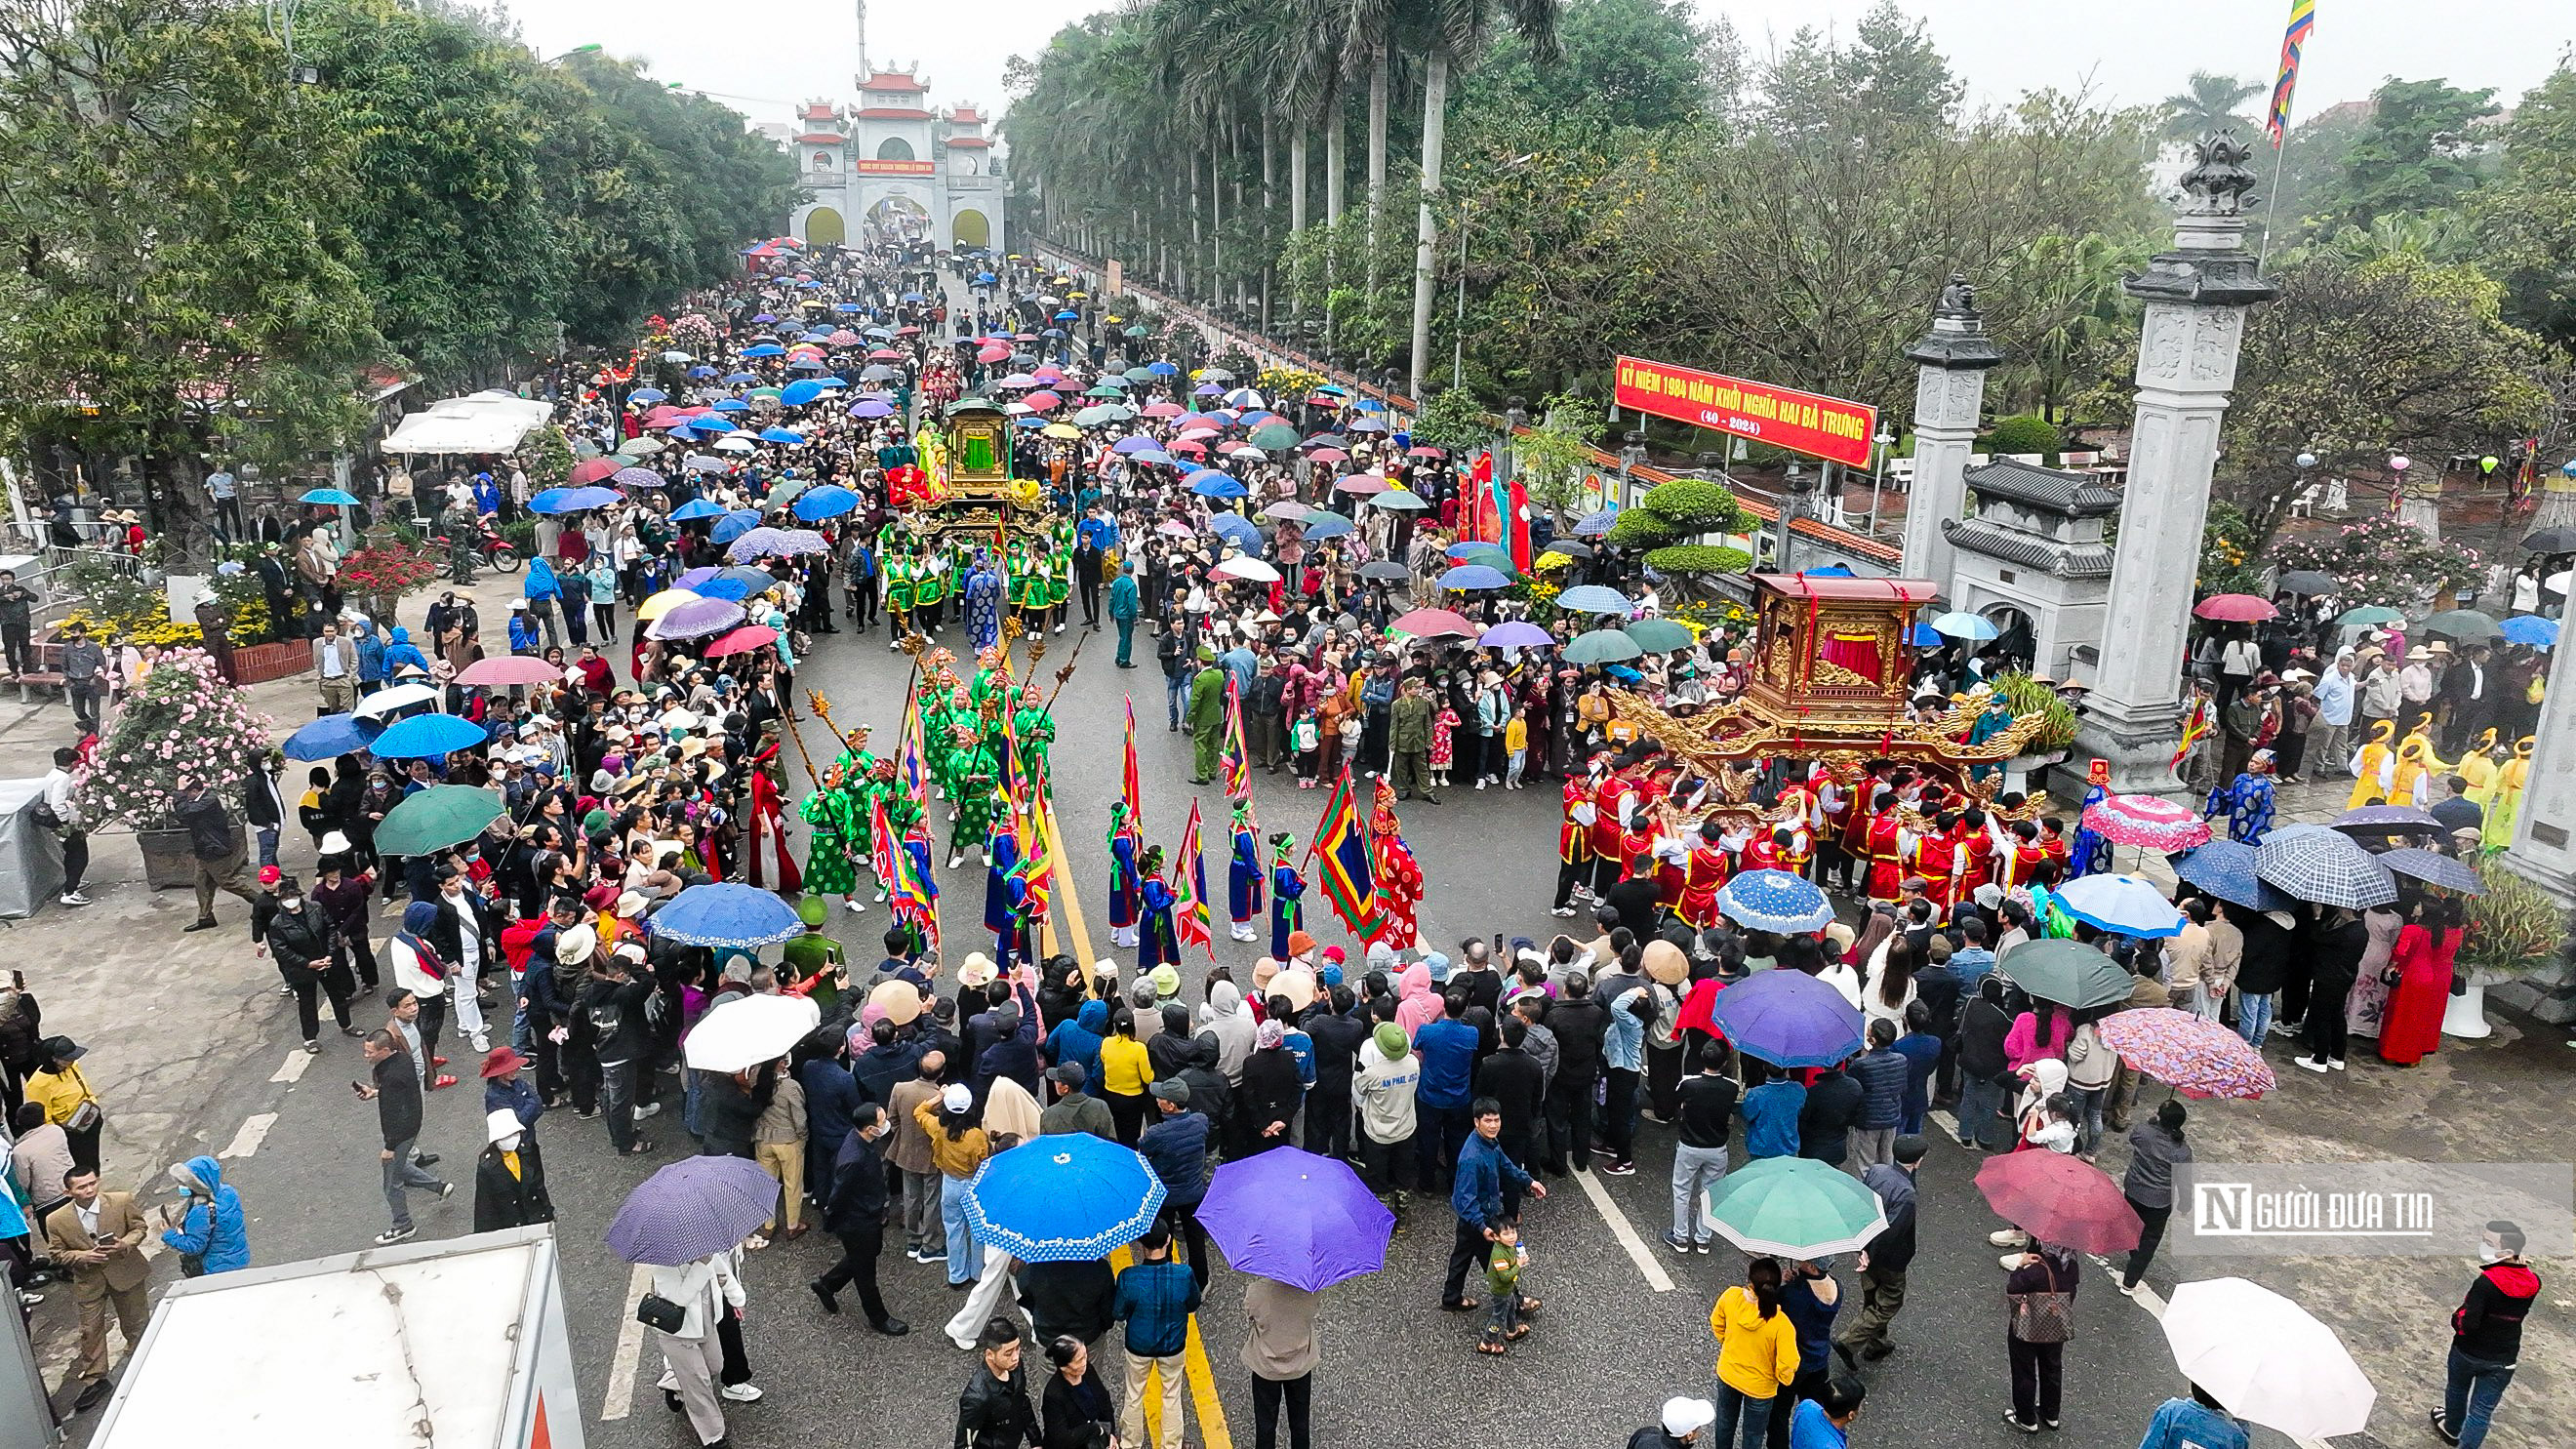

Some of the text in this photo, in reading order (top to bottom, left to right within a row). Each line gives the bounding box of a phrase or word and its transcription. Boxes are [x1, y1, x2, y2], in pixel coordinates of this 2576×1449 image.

[1621, 362, 1865, 441] KỶ NIỆM 1984 NĂM KHỞI NGHĨA HAI BÀ TRƯNG
[1700, 410, 1719, 424] (40
[1728, 417, 1761, 436] 2024)
